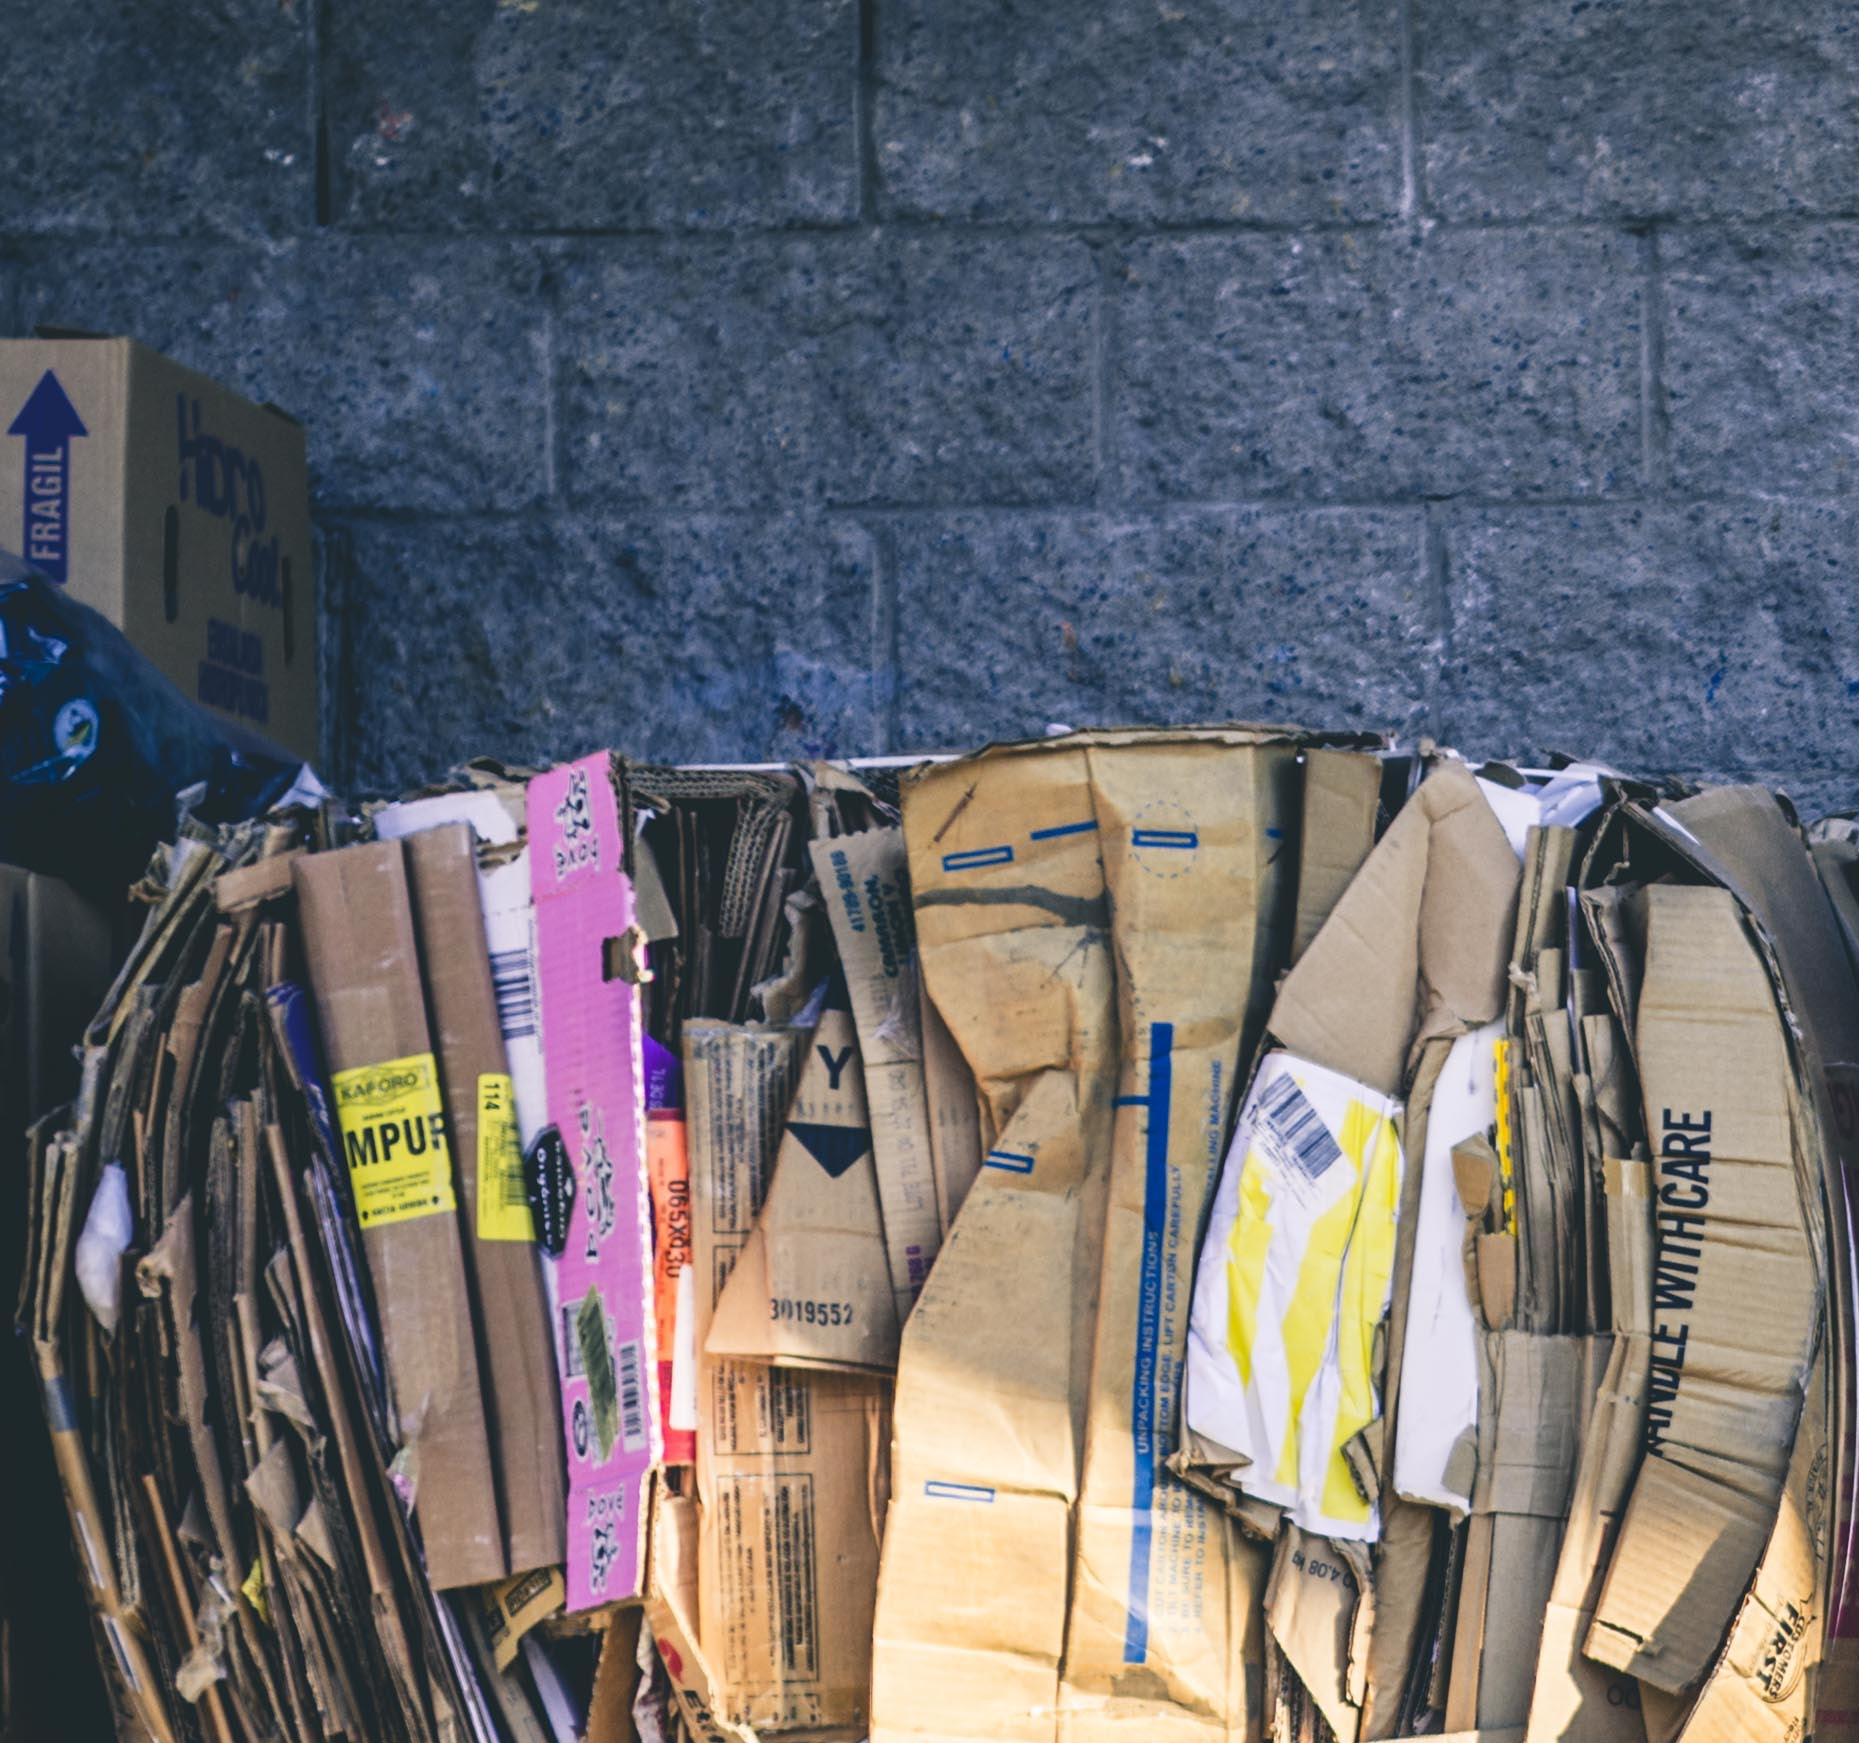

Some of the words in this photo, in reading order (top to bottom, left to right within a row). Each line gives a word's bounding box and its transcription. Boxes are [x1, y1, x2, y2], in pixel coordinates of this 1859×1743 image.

[32, 446, 63, 561] FRAGIL
[484, 1082, 501, 1111] 114
[816, 1044, 853, 1090] Y
[1210, 1060, 1222, 1125] MACHINE
[1659, 1108, 1712, 1209] CARE
[1168, 1166, 1182, 1251] CAREFULLY
[1142, 1231, 1158, 1353] INSTRUCTIONS
[1164, 1255, 1177, 1314] CARTON
[1655, 1211, 1706, 1311] WITH
[1162, 1321, 1175, 1350] LIFT
[1137, 1355, 1152, 1455] UNPACKING
[1308, 1559, 1341, 1581] 4.08
[1756, 1601, 1799, 1692] FIRST
[1769, 1614, 1806, 1701] CUSTOMERS
